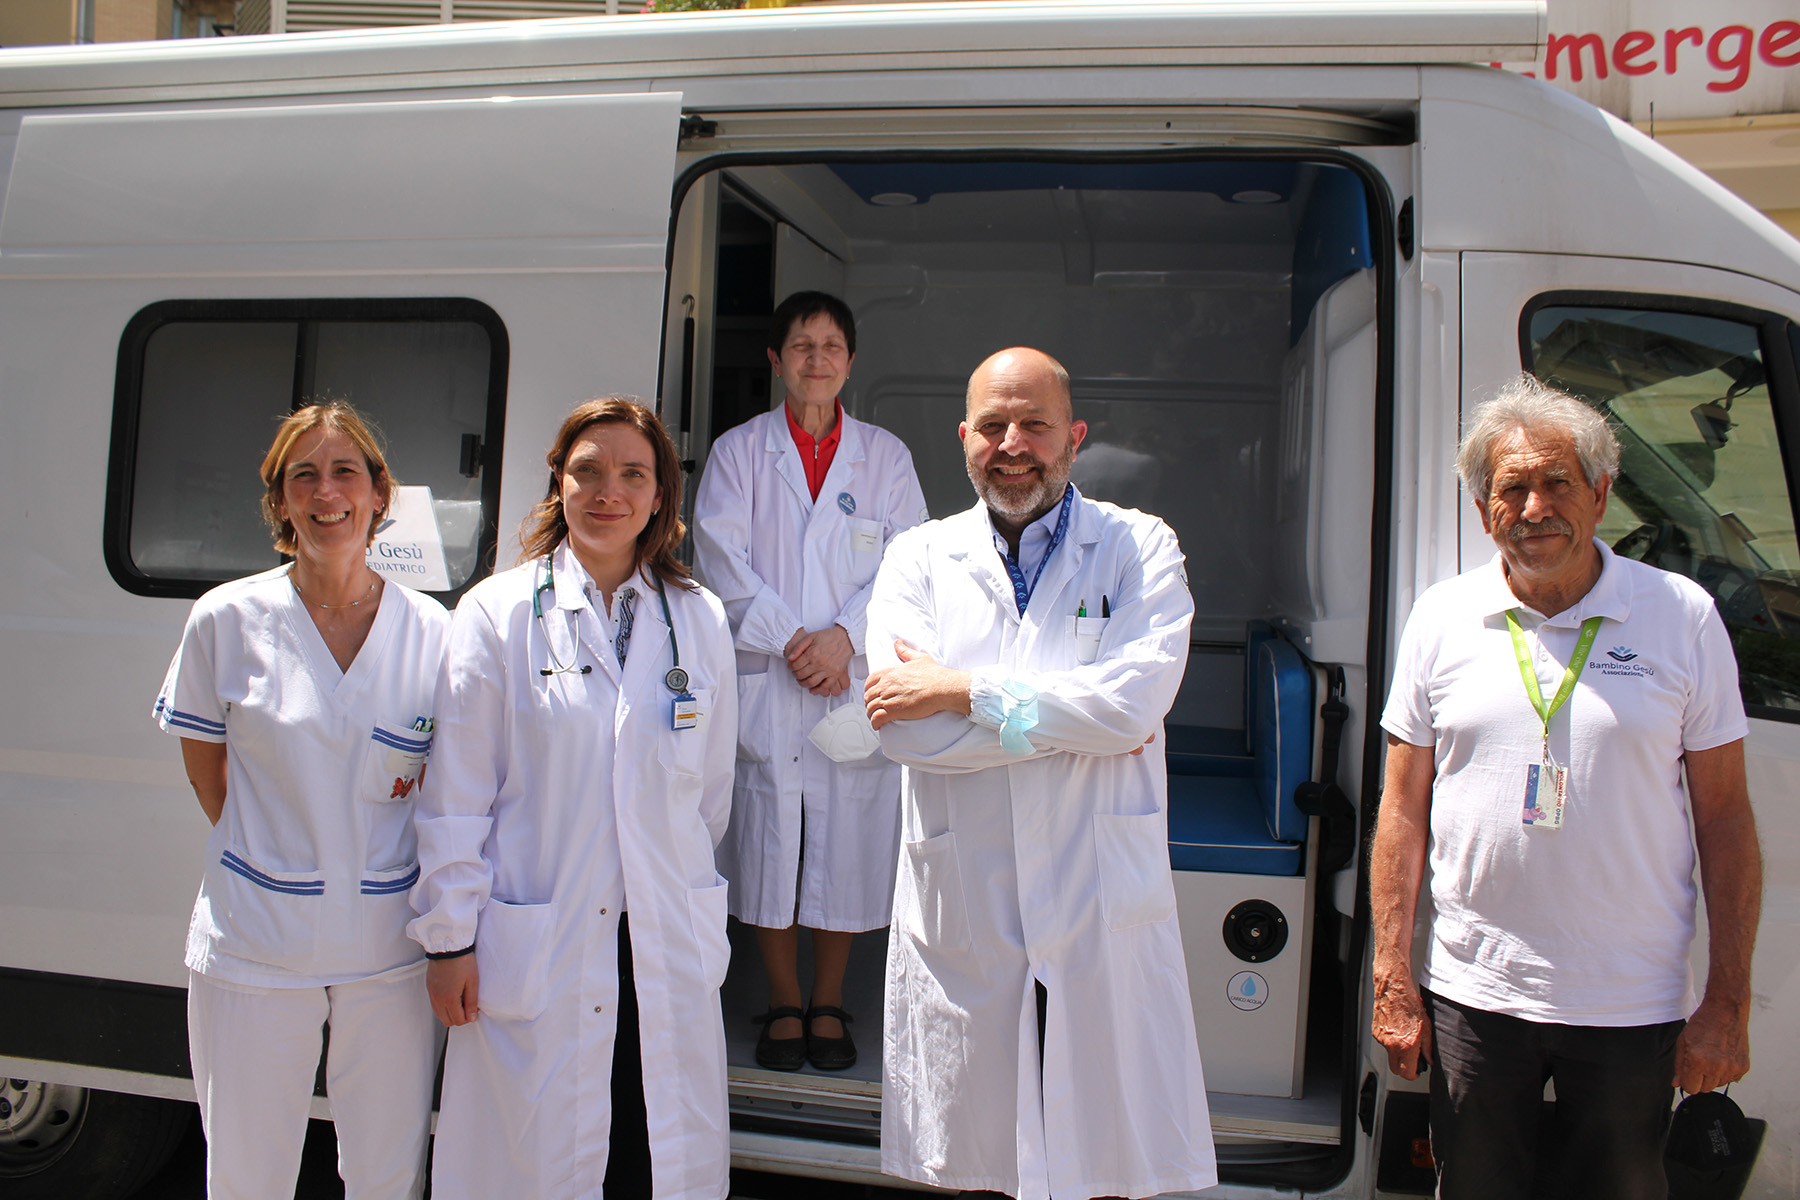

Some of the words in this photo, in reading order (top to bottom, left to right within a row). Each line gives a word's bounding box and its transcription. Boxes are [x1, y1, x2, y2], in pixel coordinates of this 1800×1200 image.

[1490, 20, 1800, 93] merge
[378, 542, 423, 559] Gesù
[367, 562, 426, 574] EDIATRICO
[1589, 661, 1631, 671] Bambino
[1633, 664, 1655, 676] Gesù
